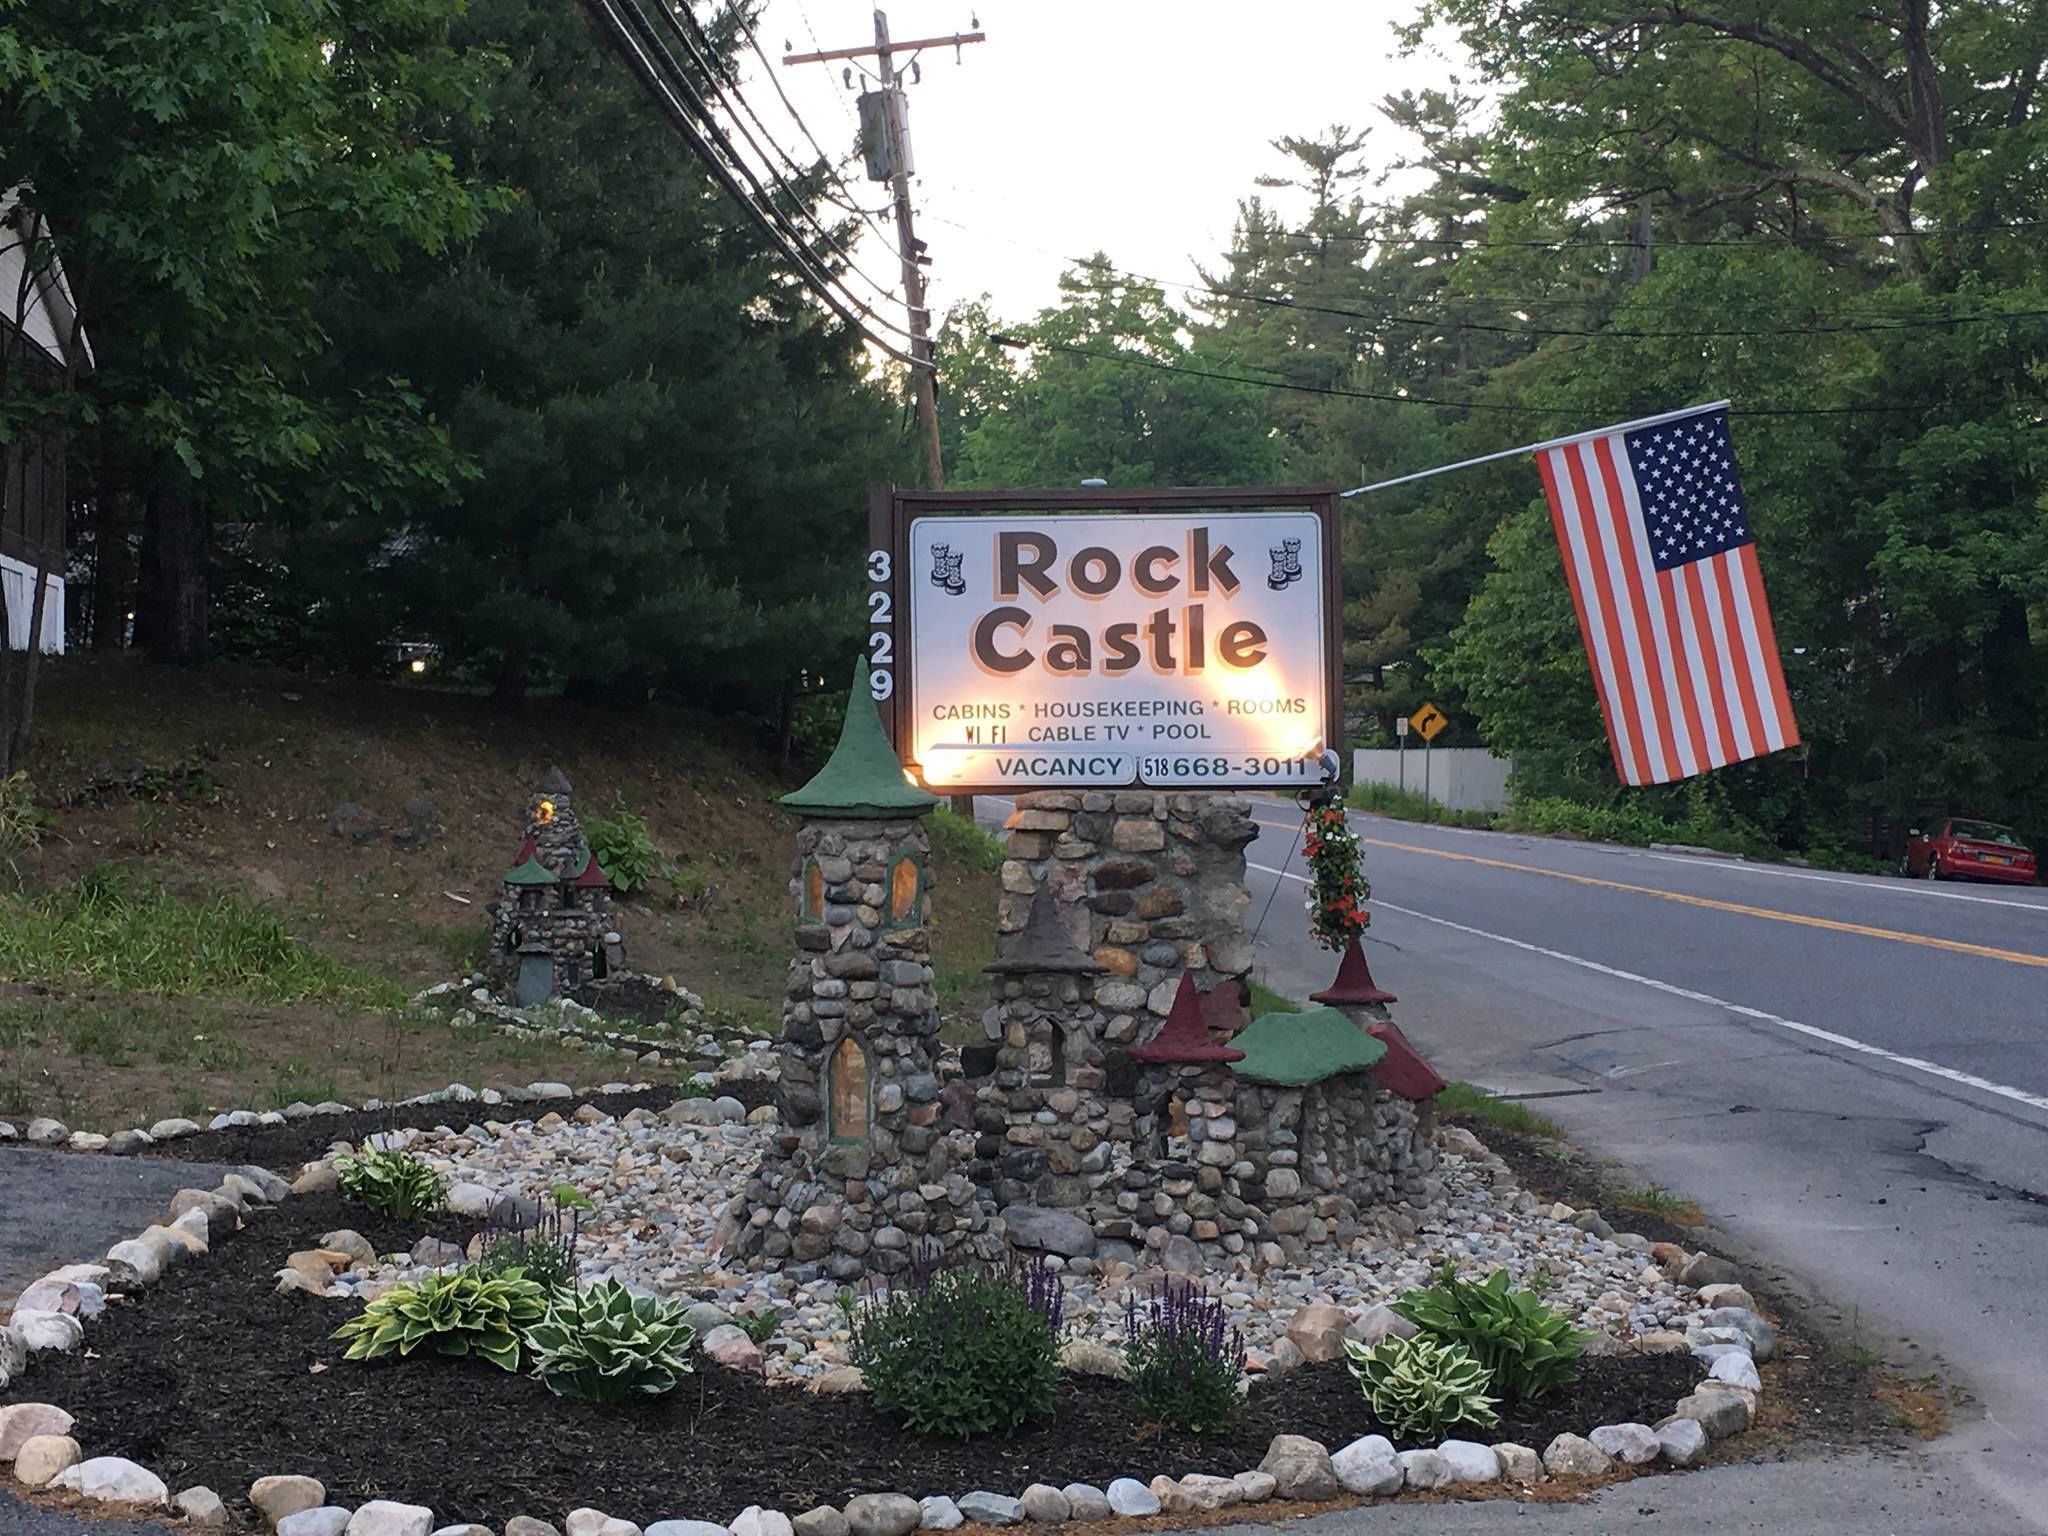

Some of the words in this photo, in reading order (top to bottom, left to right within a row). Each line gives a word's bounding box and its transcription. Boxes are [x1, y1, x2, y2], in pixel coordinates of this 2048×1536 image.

[992, 527, 1242, 603] Rock
[868, 550, 893, 701] 3229
[968, 603, 1267, 678] Castle
[933, 703, 1011, 721] CABINS
[1034, 700, 1204, 718] HOUSEKEEPING
[1227, 698, 1306, 715] ROOMS
[1028, 725, 1096, 742] CABLE
[1104, 725, 1130, 741] TV
[1153, 723, 1212, 740] POOL
[996, 757, 1122, 776] VACANCY
[1144, 758, 1169, 777] 518
[1173, 757, 1306, 776] 668-3011
